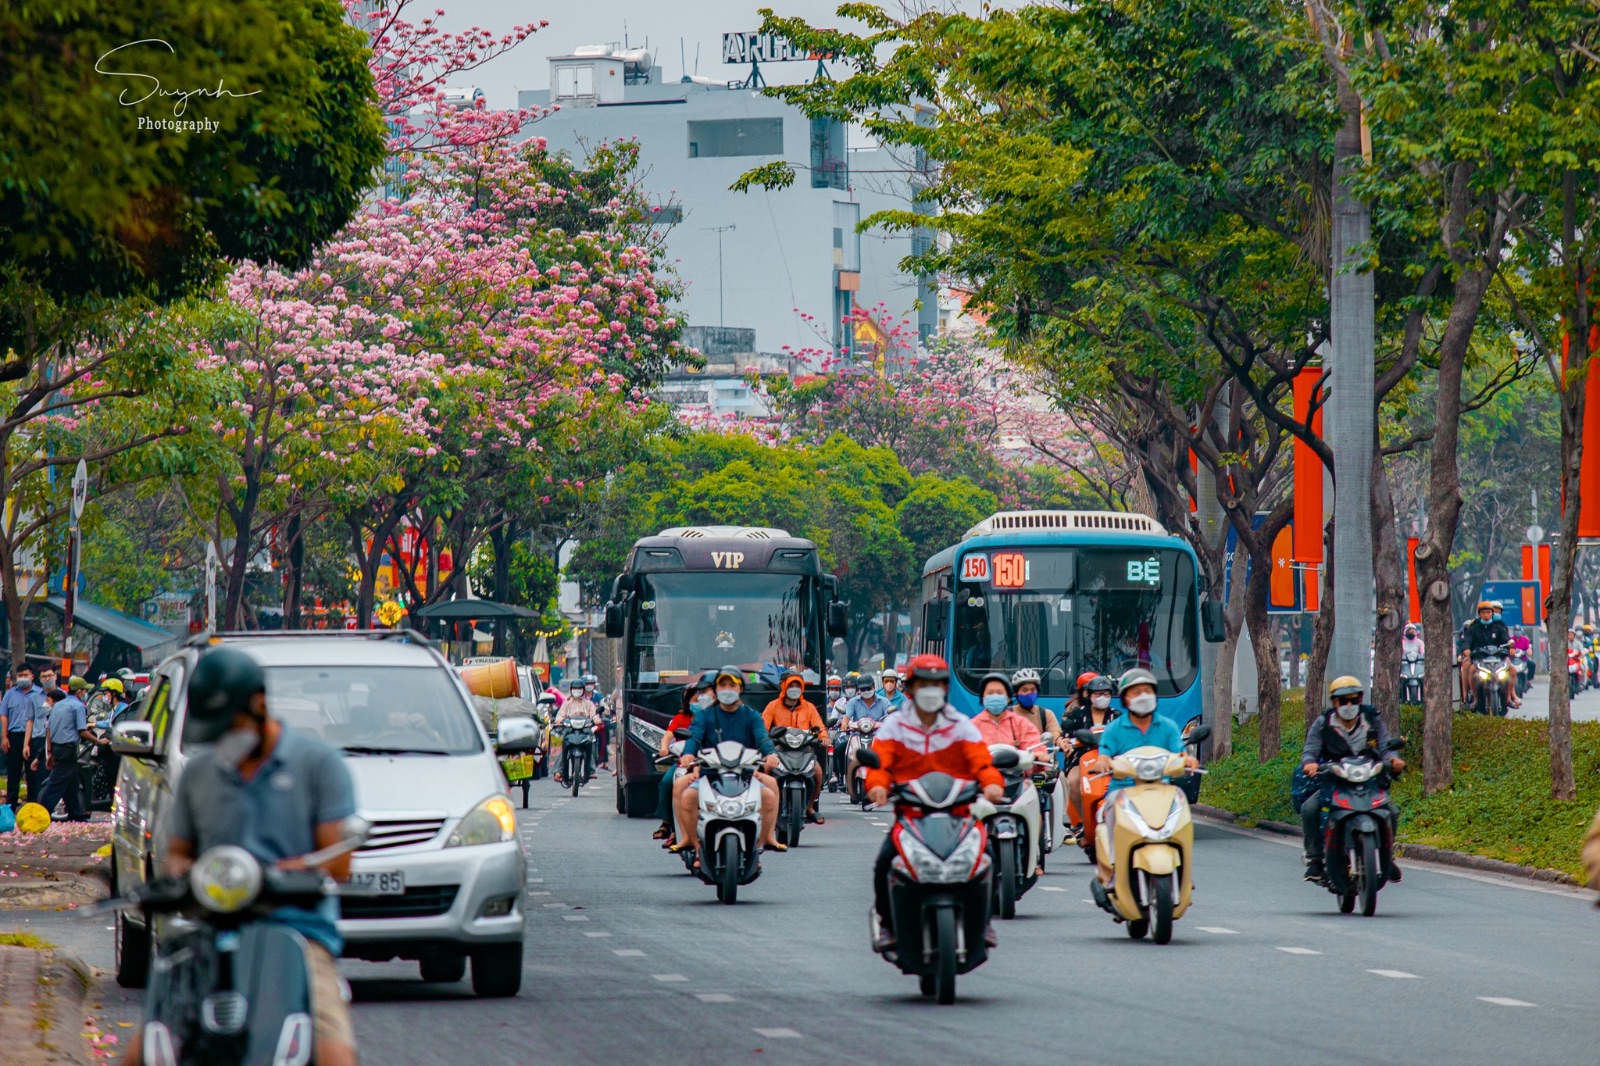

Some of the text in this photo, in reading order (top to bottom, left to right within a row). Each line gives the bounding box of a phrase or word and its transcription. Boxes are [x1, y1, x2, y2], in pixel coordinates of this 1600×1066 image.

[711, 551, 744, 569] VIP
[964, 557, 987, 578] 150
[992, 552, 1025, 587] 150
[1127, 556, 1160, 585] BỆ
